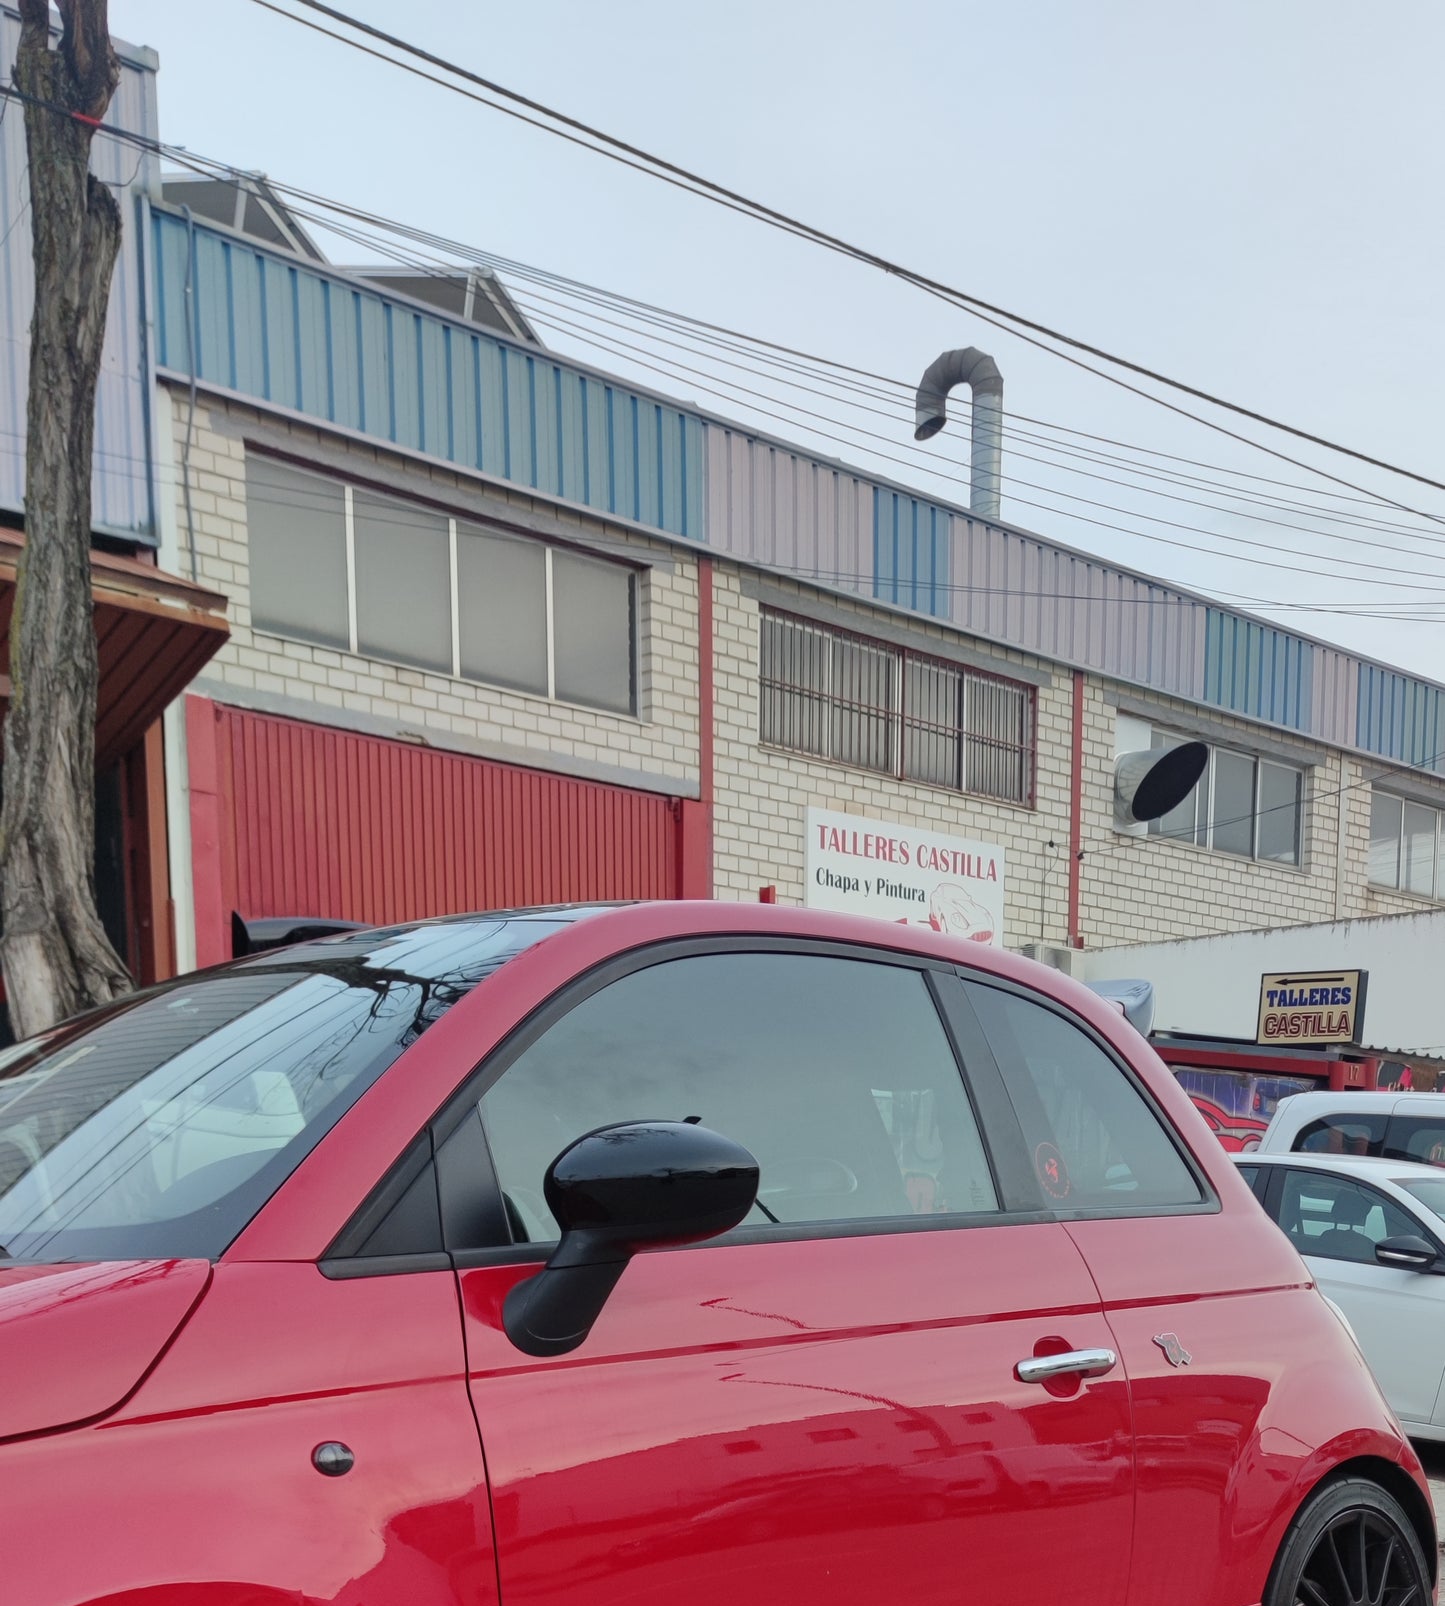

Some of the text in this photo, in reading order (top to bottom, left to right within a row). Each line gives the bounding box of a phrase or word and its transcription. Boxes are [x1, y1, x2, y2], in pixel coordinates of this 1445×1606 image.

[816, 824, 998, 882] TALLERES CASTILLA
[816, 866, 926, 903] Chapa y Pintura
[1266, 987, 1352, 1008] TALLERES
[1263, 1011, 1352, 1038] CASTILLA
[1349, 1064, 1360, 1081] 17
